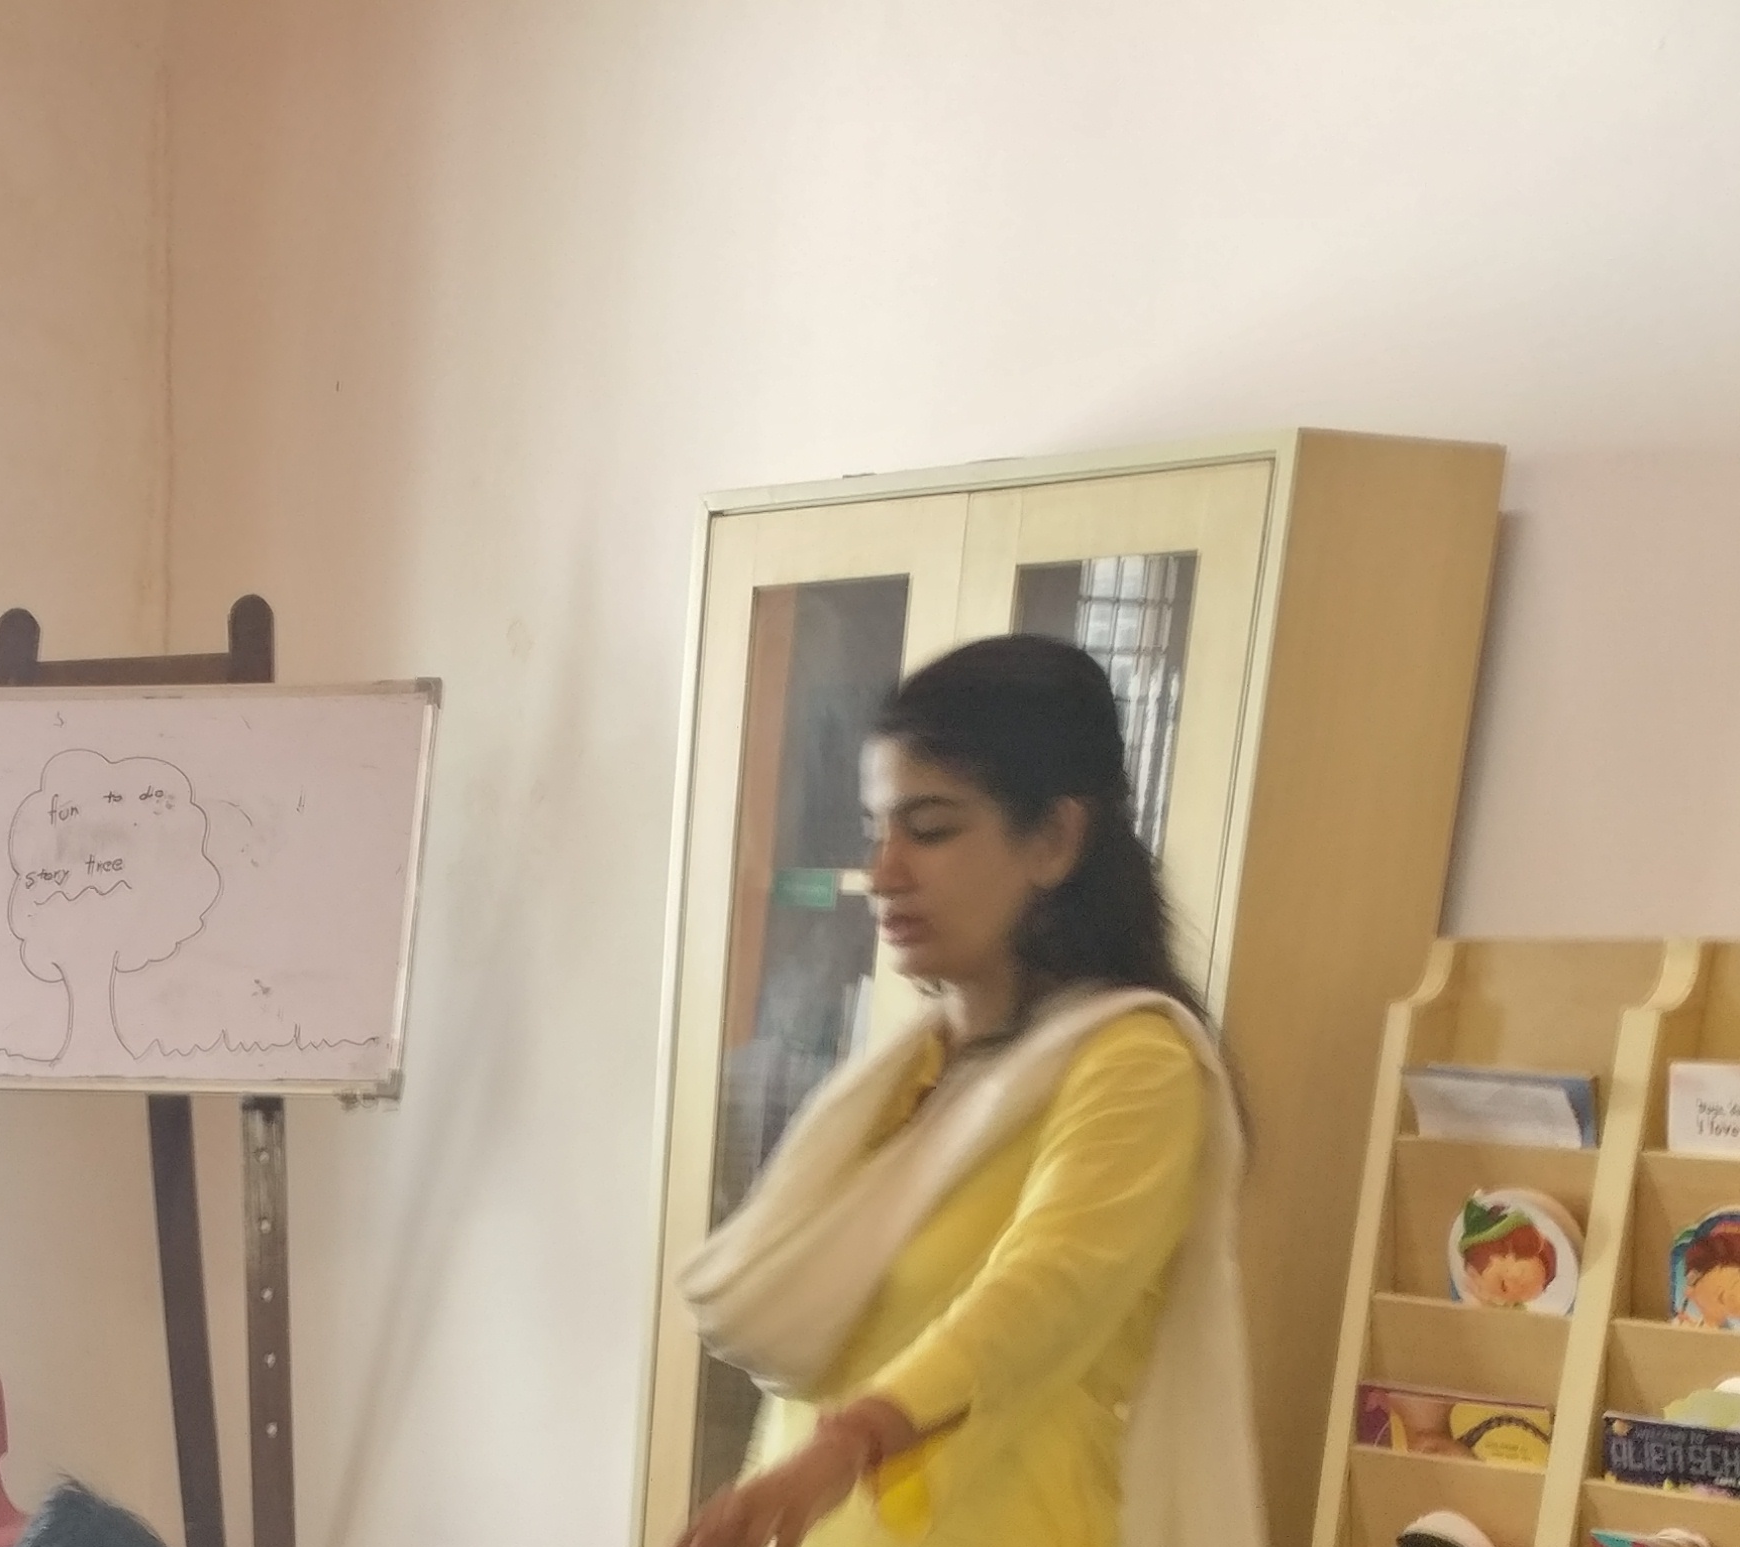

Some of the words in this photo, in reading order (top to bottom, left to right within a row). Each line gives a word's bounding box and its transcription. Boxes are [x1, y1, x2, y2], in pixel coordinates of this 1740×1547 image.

[48, 793, 79, 825] fun
[103, 791, 123, 803] to
[139, 785, 164, 801] do
[25, 868, 70, 890] story
[85, 854, 123, 876] tree
